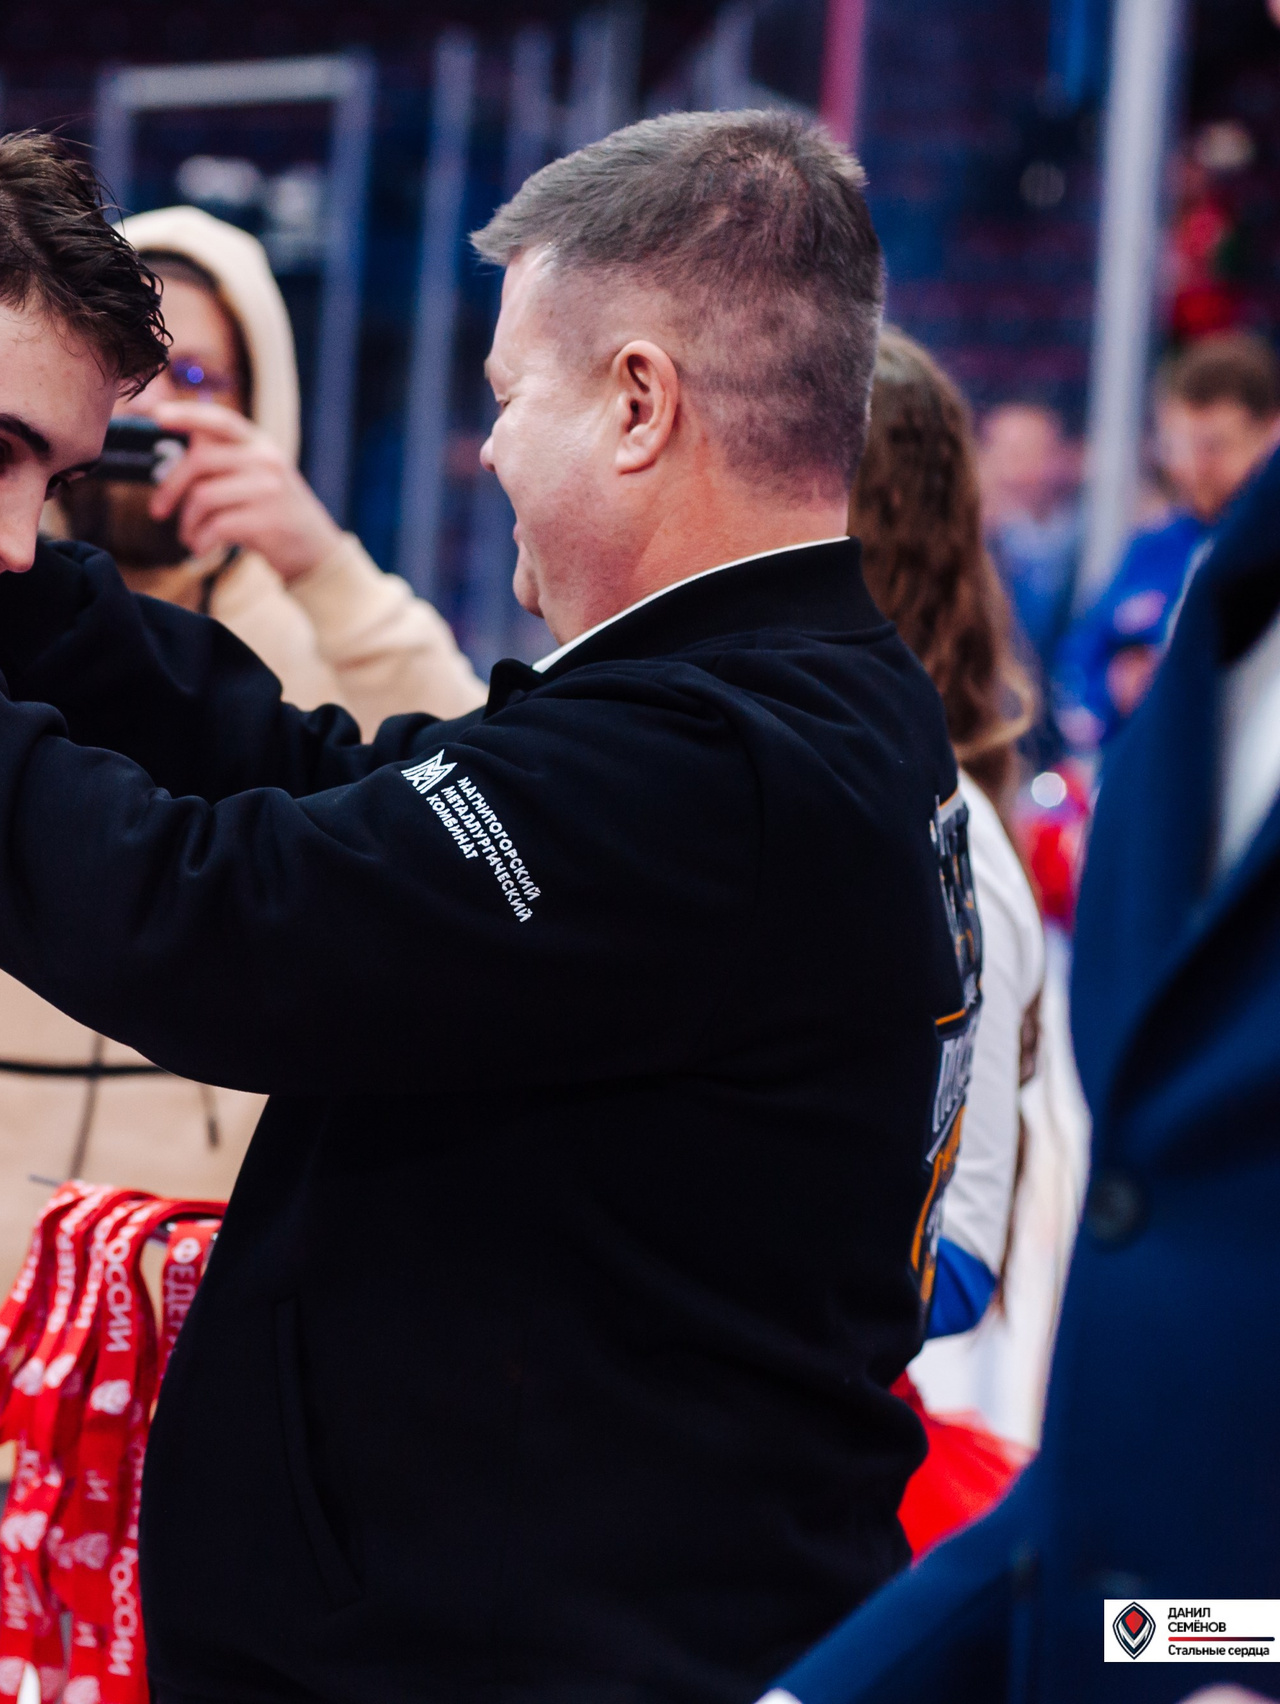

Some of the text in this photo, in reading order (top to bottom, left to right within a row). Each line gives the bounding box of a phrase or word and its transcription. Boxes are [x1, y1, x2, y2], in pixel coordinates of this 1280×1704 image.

[425, 795, 480, 860] КОМБИНАТ
[440, 785, 533, 923] МЕТАЛЛУРГИЧЕСКИЙ
[456, 776, 541, 901] МАГНИТОГОРСКИЙ
